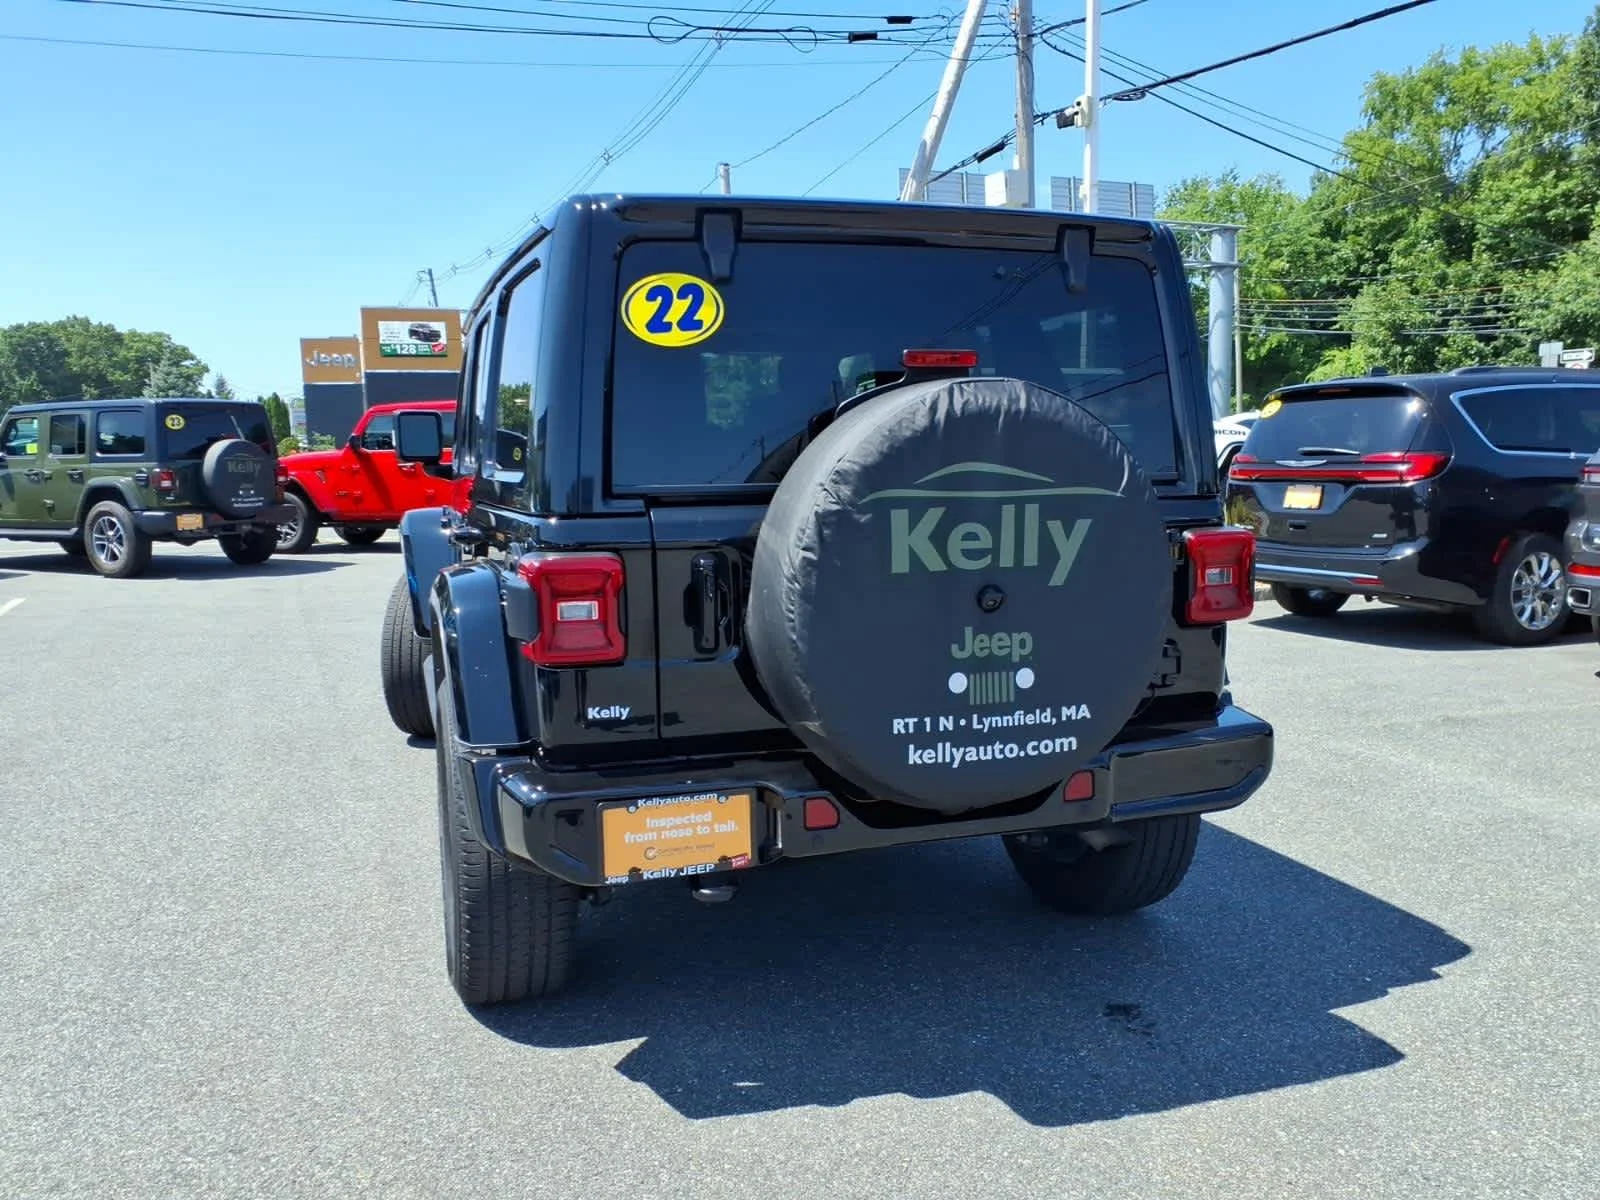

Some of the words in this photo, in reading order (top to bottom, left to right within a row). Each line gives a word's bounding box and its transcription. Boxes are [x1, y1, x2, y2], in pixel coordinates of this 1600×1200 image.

[646, 283, 704, 333] 22
[305, 350, 356, 368] Jeep
[890, 503, 1093, 586] Kelly
[951, 626, 1033, 662] Jeep
[587, 705, 631, 720] Kelly
[892, 717, 918, 735] RT
[924, 716, 931, 733] 1
[938, 715, 954, 732] N
[972, 708, 1057, 733] Lynnfield,
[1061, 703, 1092, 721] MA
[908, 736, 1078, 769] kellyauto.com
[637, 792, 718, 808] Kellyauto.com
[646, 811, 712, 829] Inspected
[624, 831, 657, 844] from
[661, 827, 693, 840] nose
[696, 824, 710, 835] to
[605, 875, 629, 885] Jeep
[642, 867, 678, 881] Kelly
[680, 863, 716, 876] JEEP
